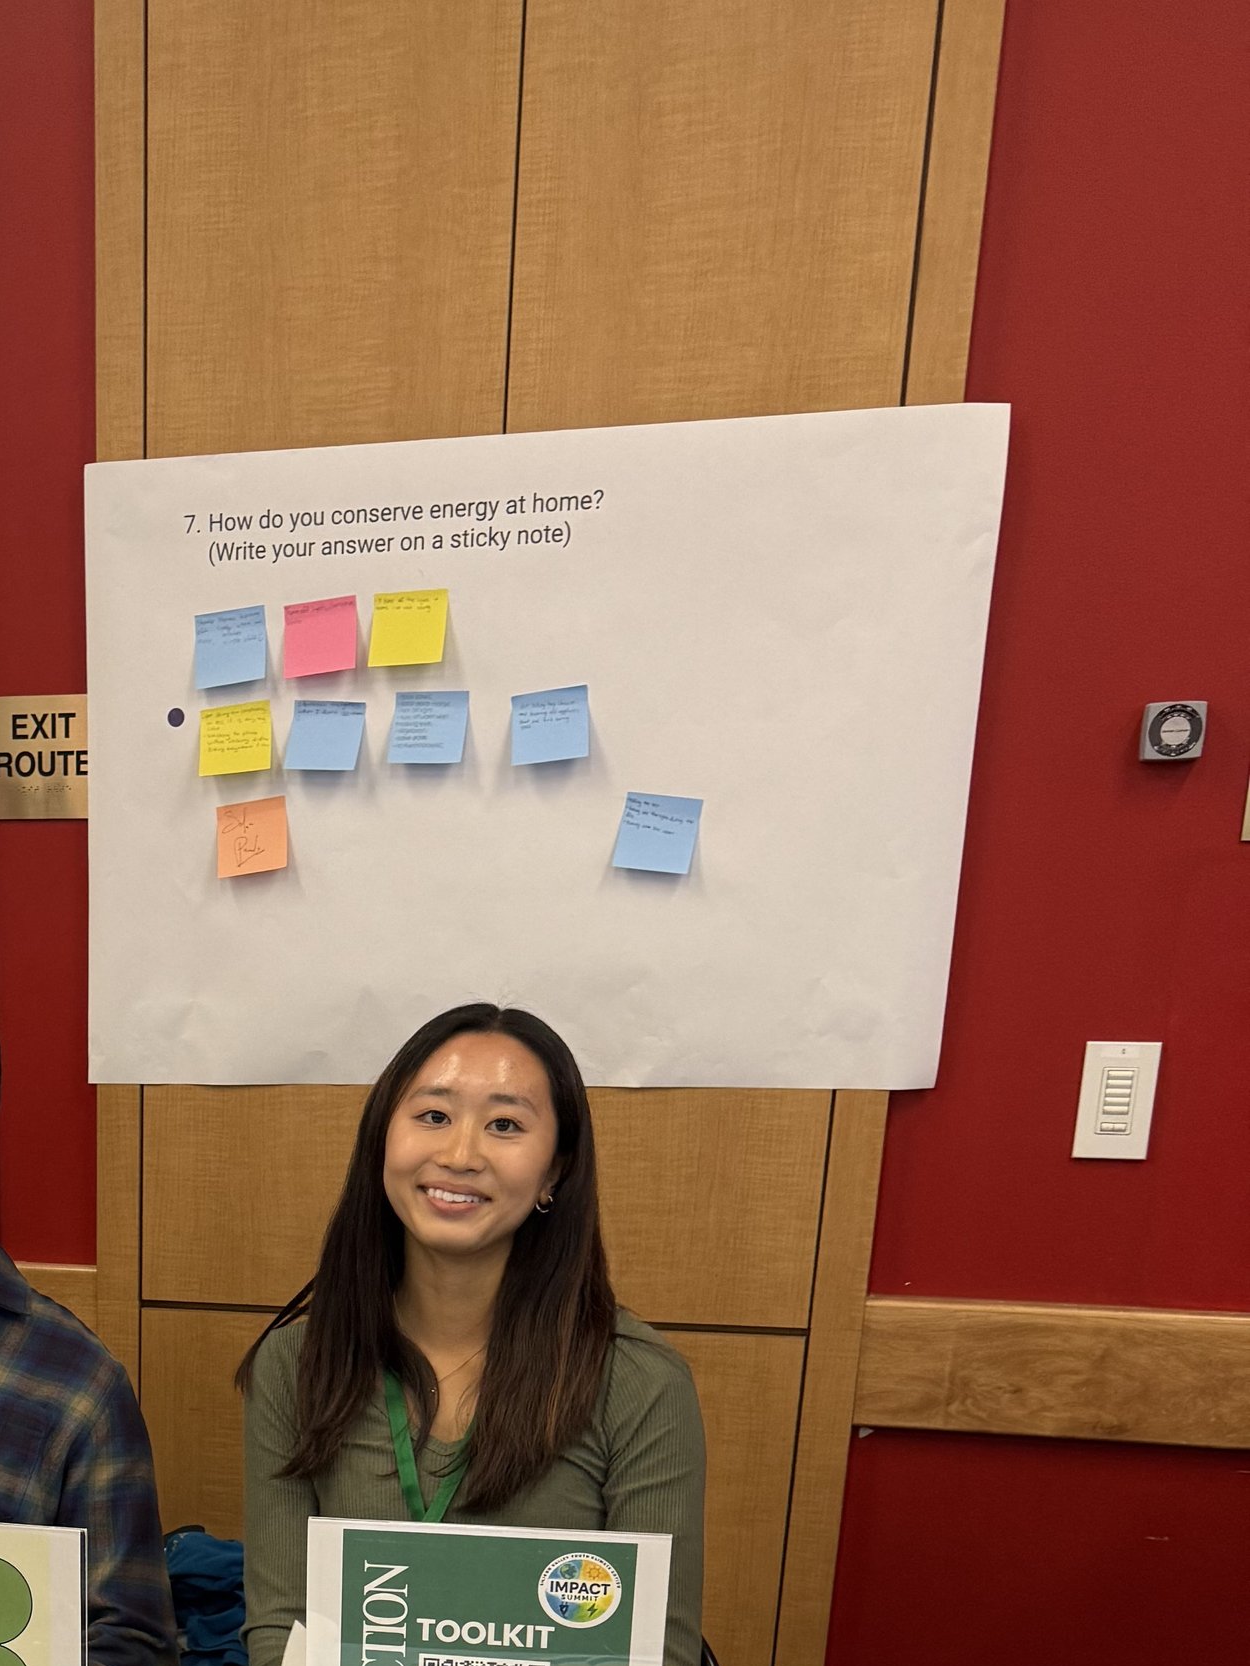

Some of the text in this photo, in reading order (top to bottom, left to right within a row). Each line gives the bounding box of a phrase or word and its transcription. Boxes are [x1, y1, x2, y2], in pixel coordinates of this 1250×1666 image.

[184, 490, 603, 534] 7. How do you conserve energy at home?
[209, 521, 571, 566] (Write your answer on a sticky note)
[12, 713, 76, 739] EXIT
[550, 1581, 610, 1595] IMPACT
[417, 1618, 555, 1649] TOOLKIT
